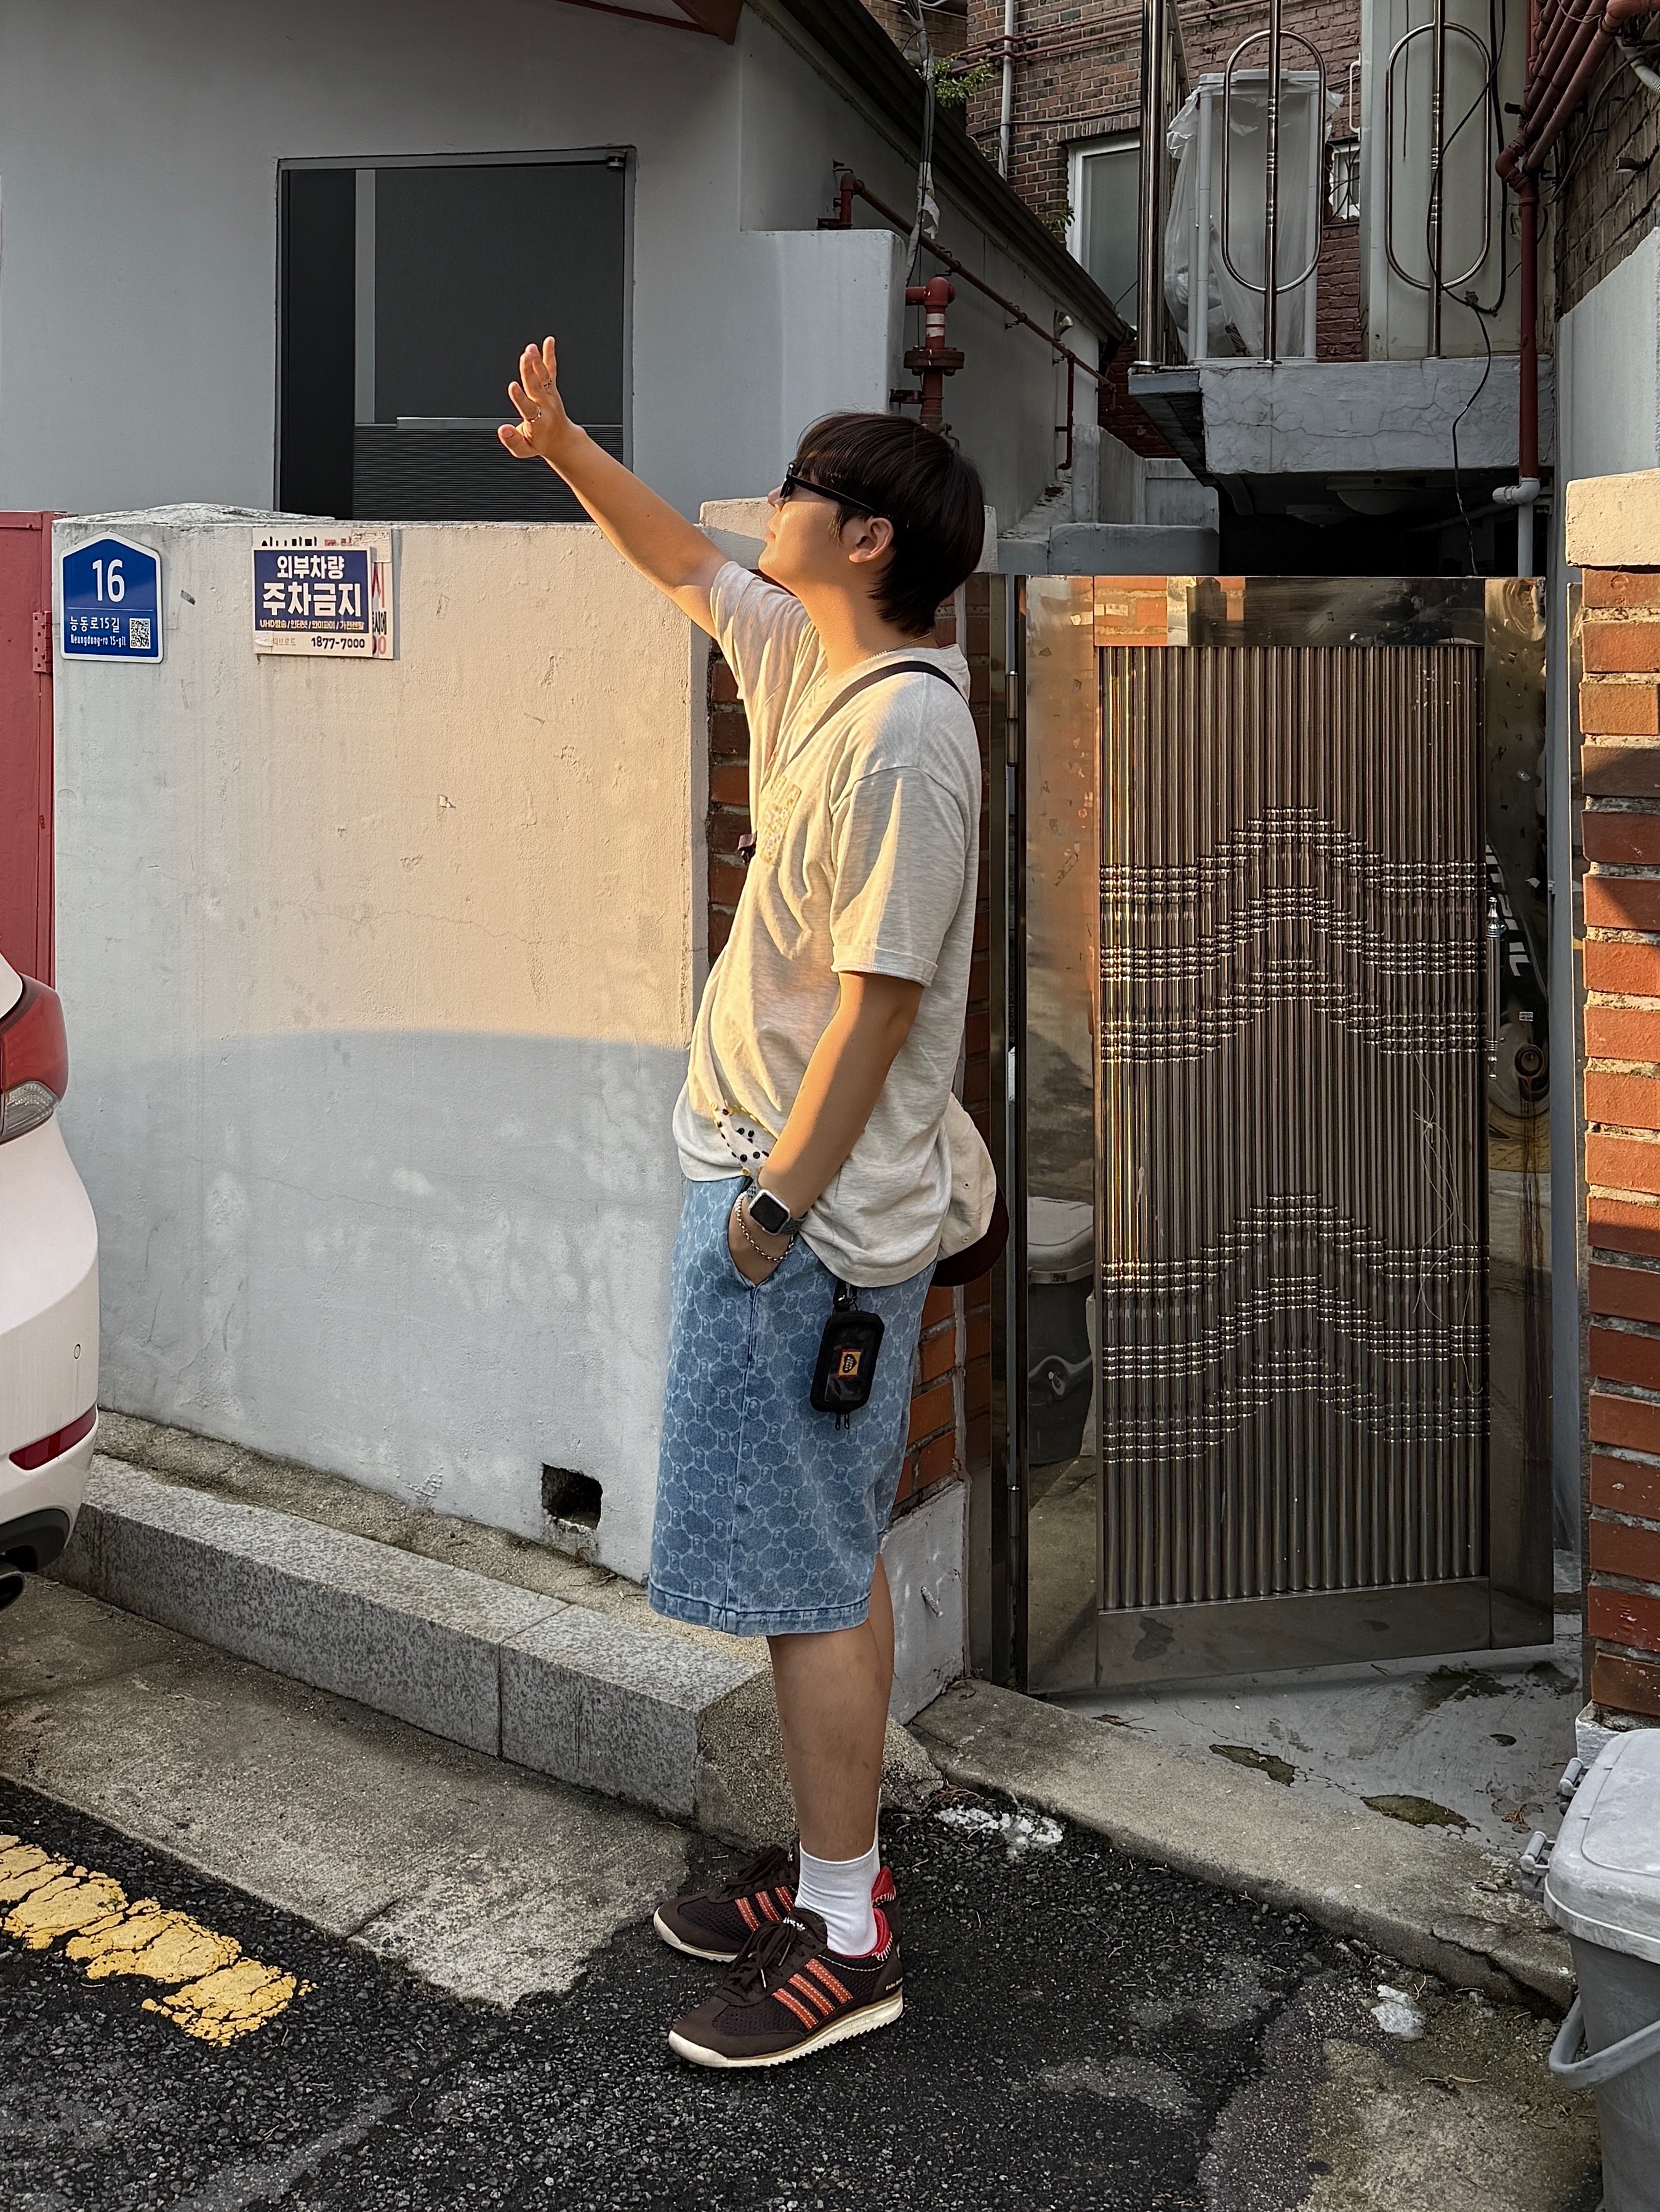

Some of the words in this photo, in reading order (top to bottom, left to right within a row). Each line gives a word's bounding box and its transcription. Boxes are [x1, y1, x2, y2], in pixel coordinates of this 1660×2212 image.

[277, 555, 345, 579] 외부차량
[93, 559, 125, 603] 16
[263, 582, 361, 617] 주차금지
[70, 616, 119, 633] 능동로15길
[110, 636, 126, 647] 15-gil
[311, 636, 365, 650] 1877-7000
